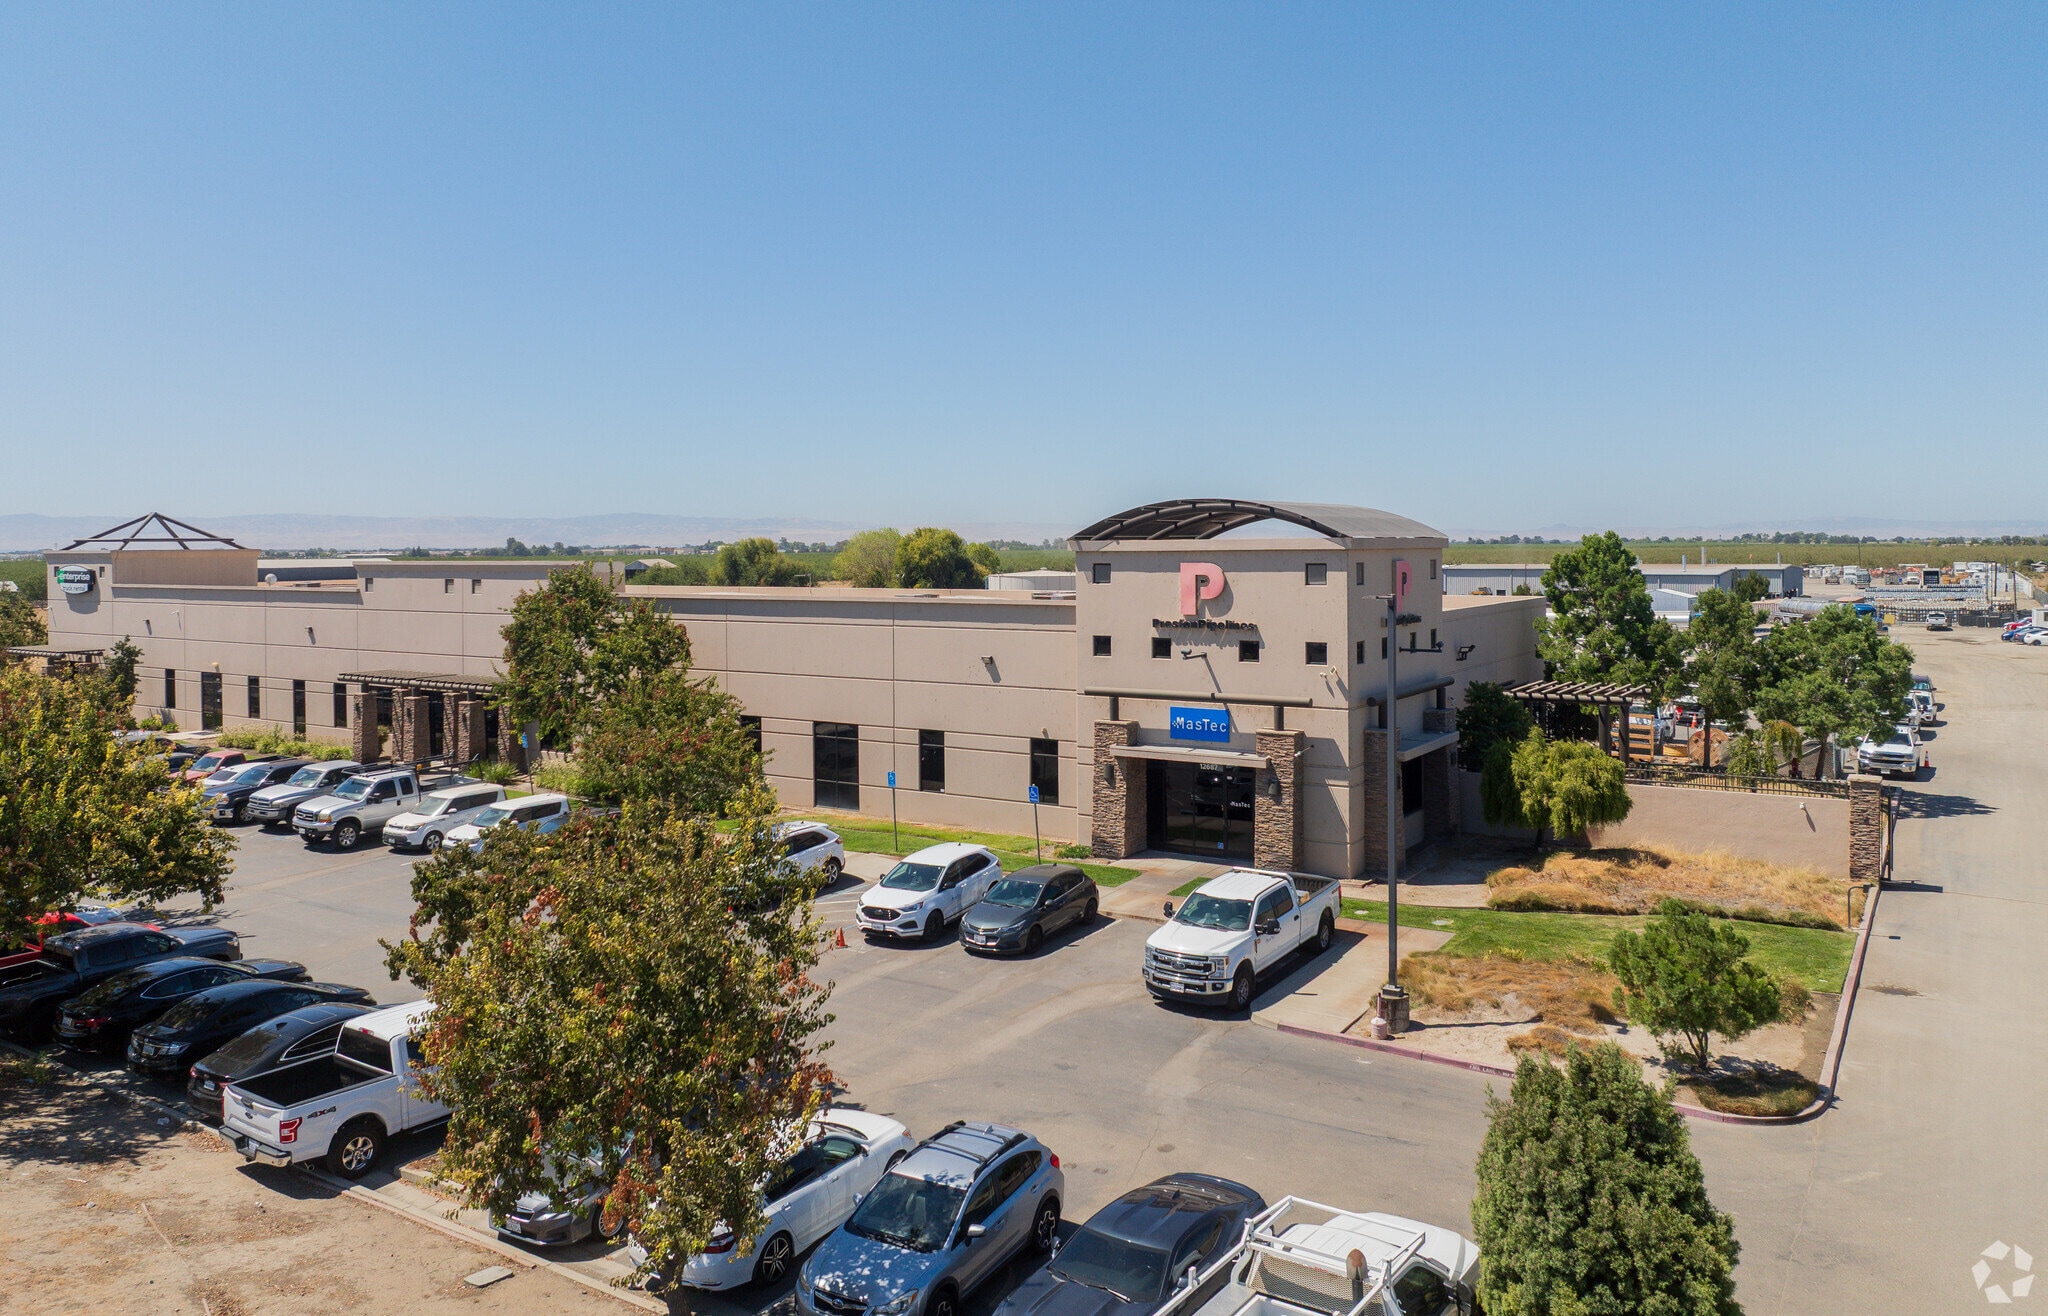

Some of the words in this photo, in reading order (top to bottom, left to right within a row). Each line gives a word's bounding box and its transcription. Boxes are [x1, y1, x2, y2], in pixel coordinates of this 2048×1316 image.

[59, 572, 91, 582] enterprise
[1180, 562, 1225, 616] P
[1174, 716, 1227, 733] MasTec
[1229, 801, 1251, 809] MasTec
